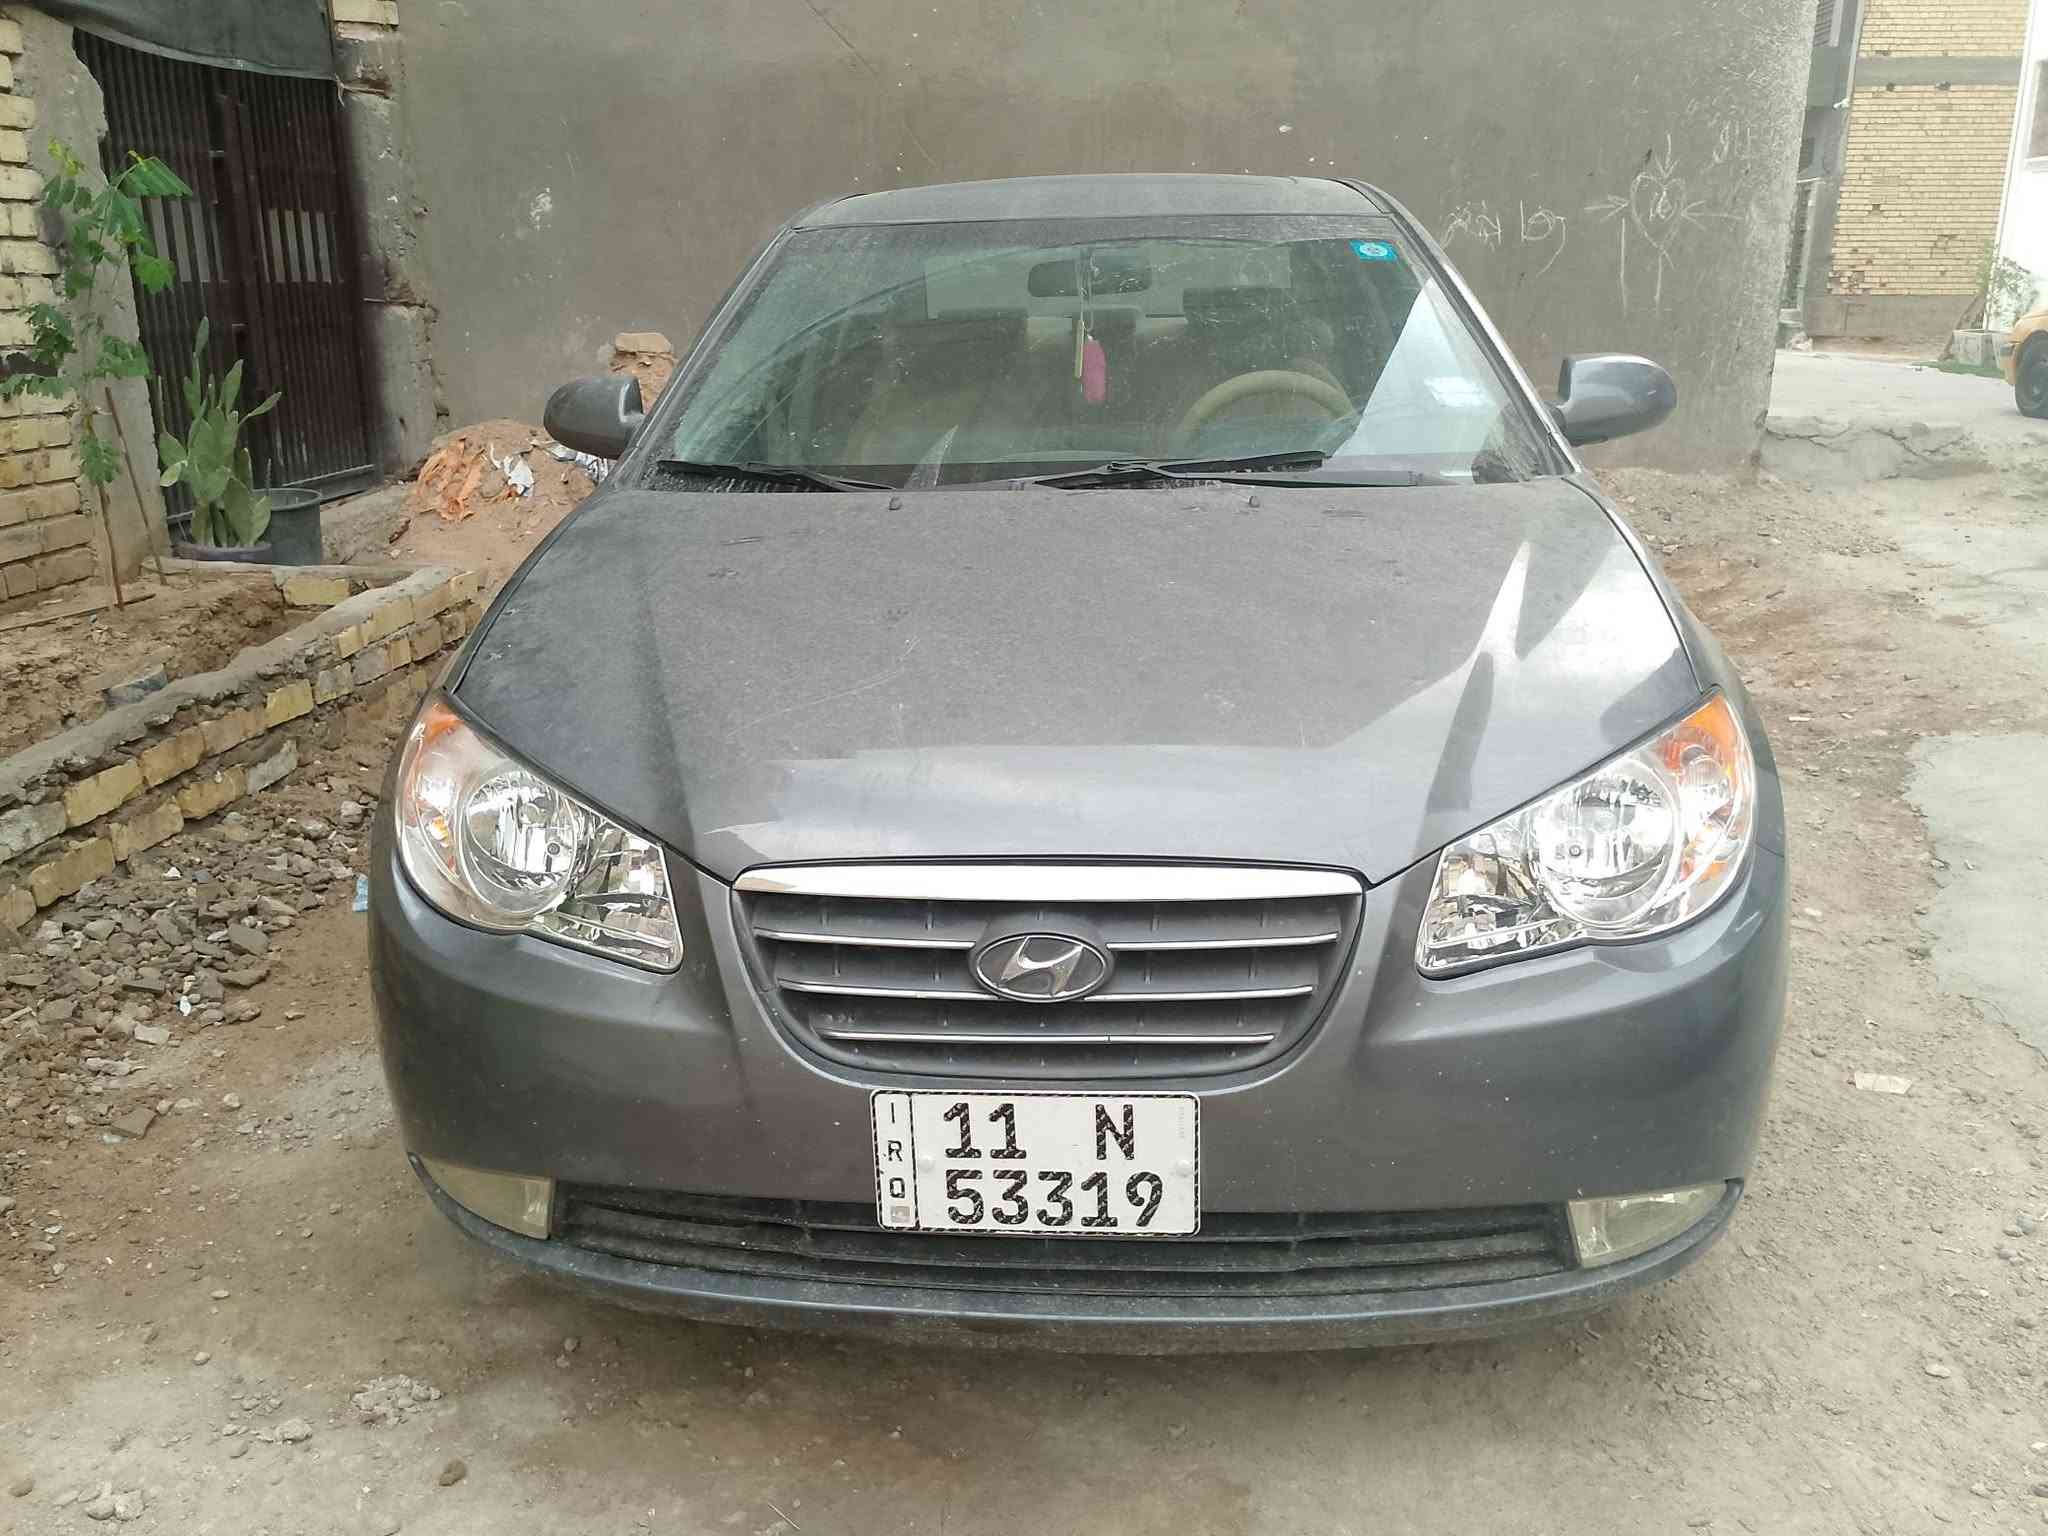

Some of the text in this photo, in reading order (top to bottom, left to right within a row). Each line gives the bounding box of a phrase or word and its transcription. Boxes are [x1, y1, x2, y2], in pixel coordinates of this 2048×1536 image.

[943, 1102, 1134, 1160] 11 N
[946, 1168, 1163, 1227] 53319
